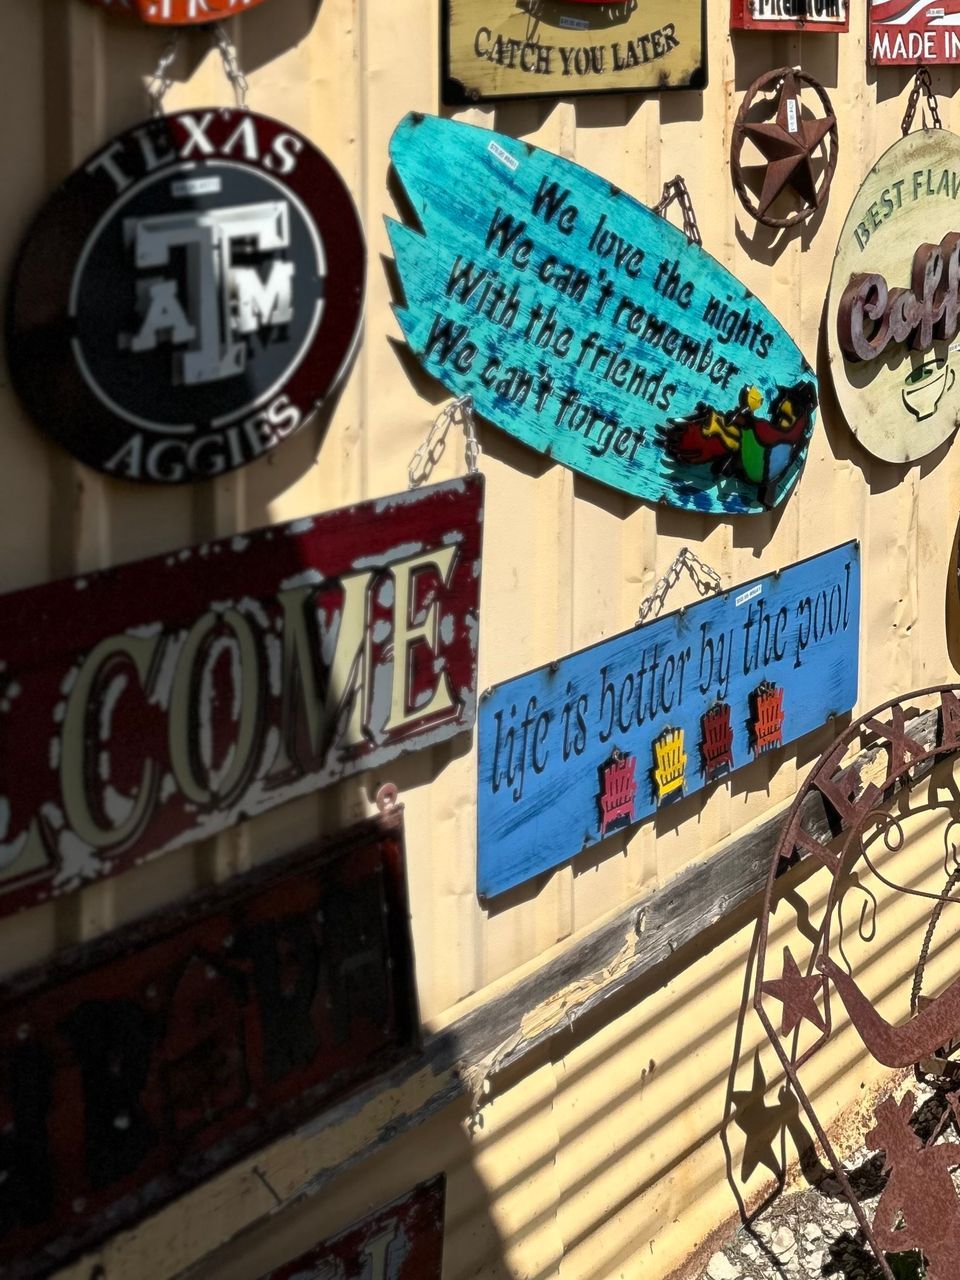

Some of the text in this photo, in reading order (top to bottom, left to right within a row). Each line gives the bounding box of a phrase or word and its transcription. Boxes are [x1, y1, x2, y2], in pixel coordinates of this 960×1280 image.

[473, 22, 681, 76] CATCH YOU LATER
[871, 29, 941, 61] MADE
[87, 114, 302, 193] TEXAS
[530, 174, 775, 360] We love the nights
[853, 179, 905, 253] BEST
[442, 254, 678, 413] With the friends
[483, 206, 742, 391] We can't remember
[104, 394, 302, 486] AGGIES
[423, 316, 647, 463] We can't forget
[490, 561, 852, 802] life is better by the pool
